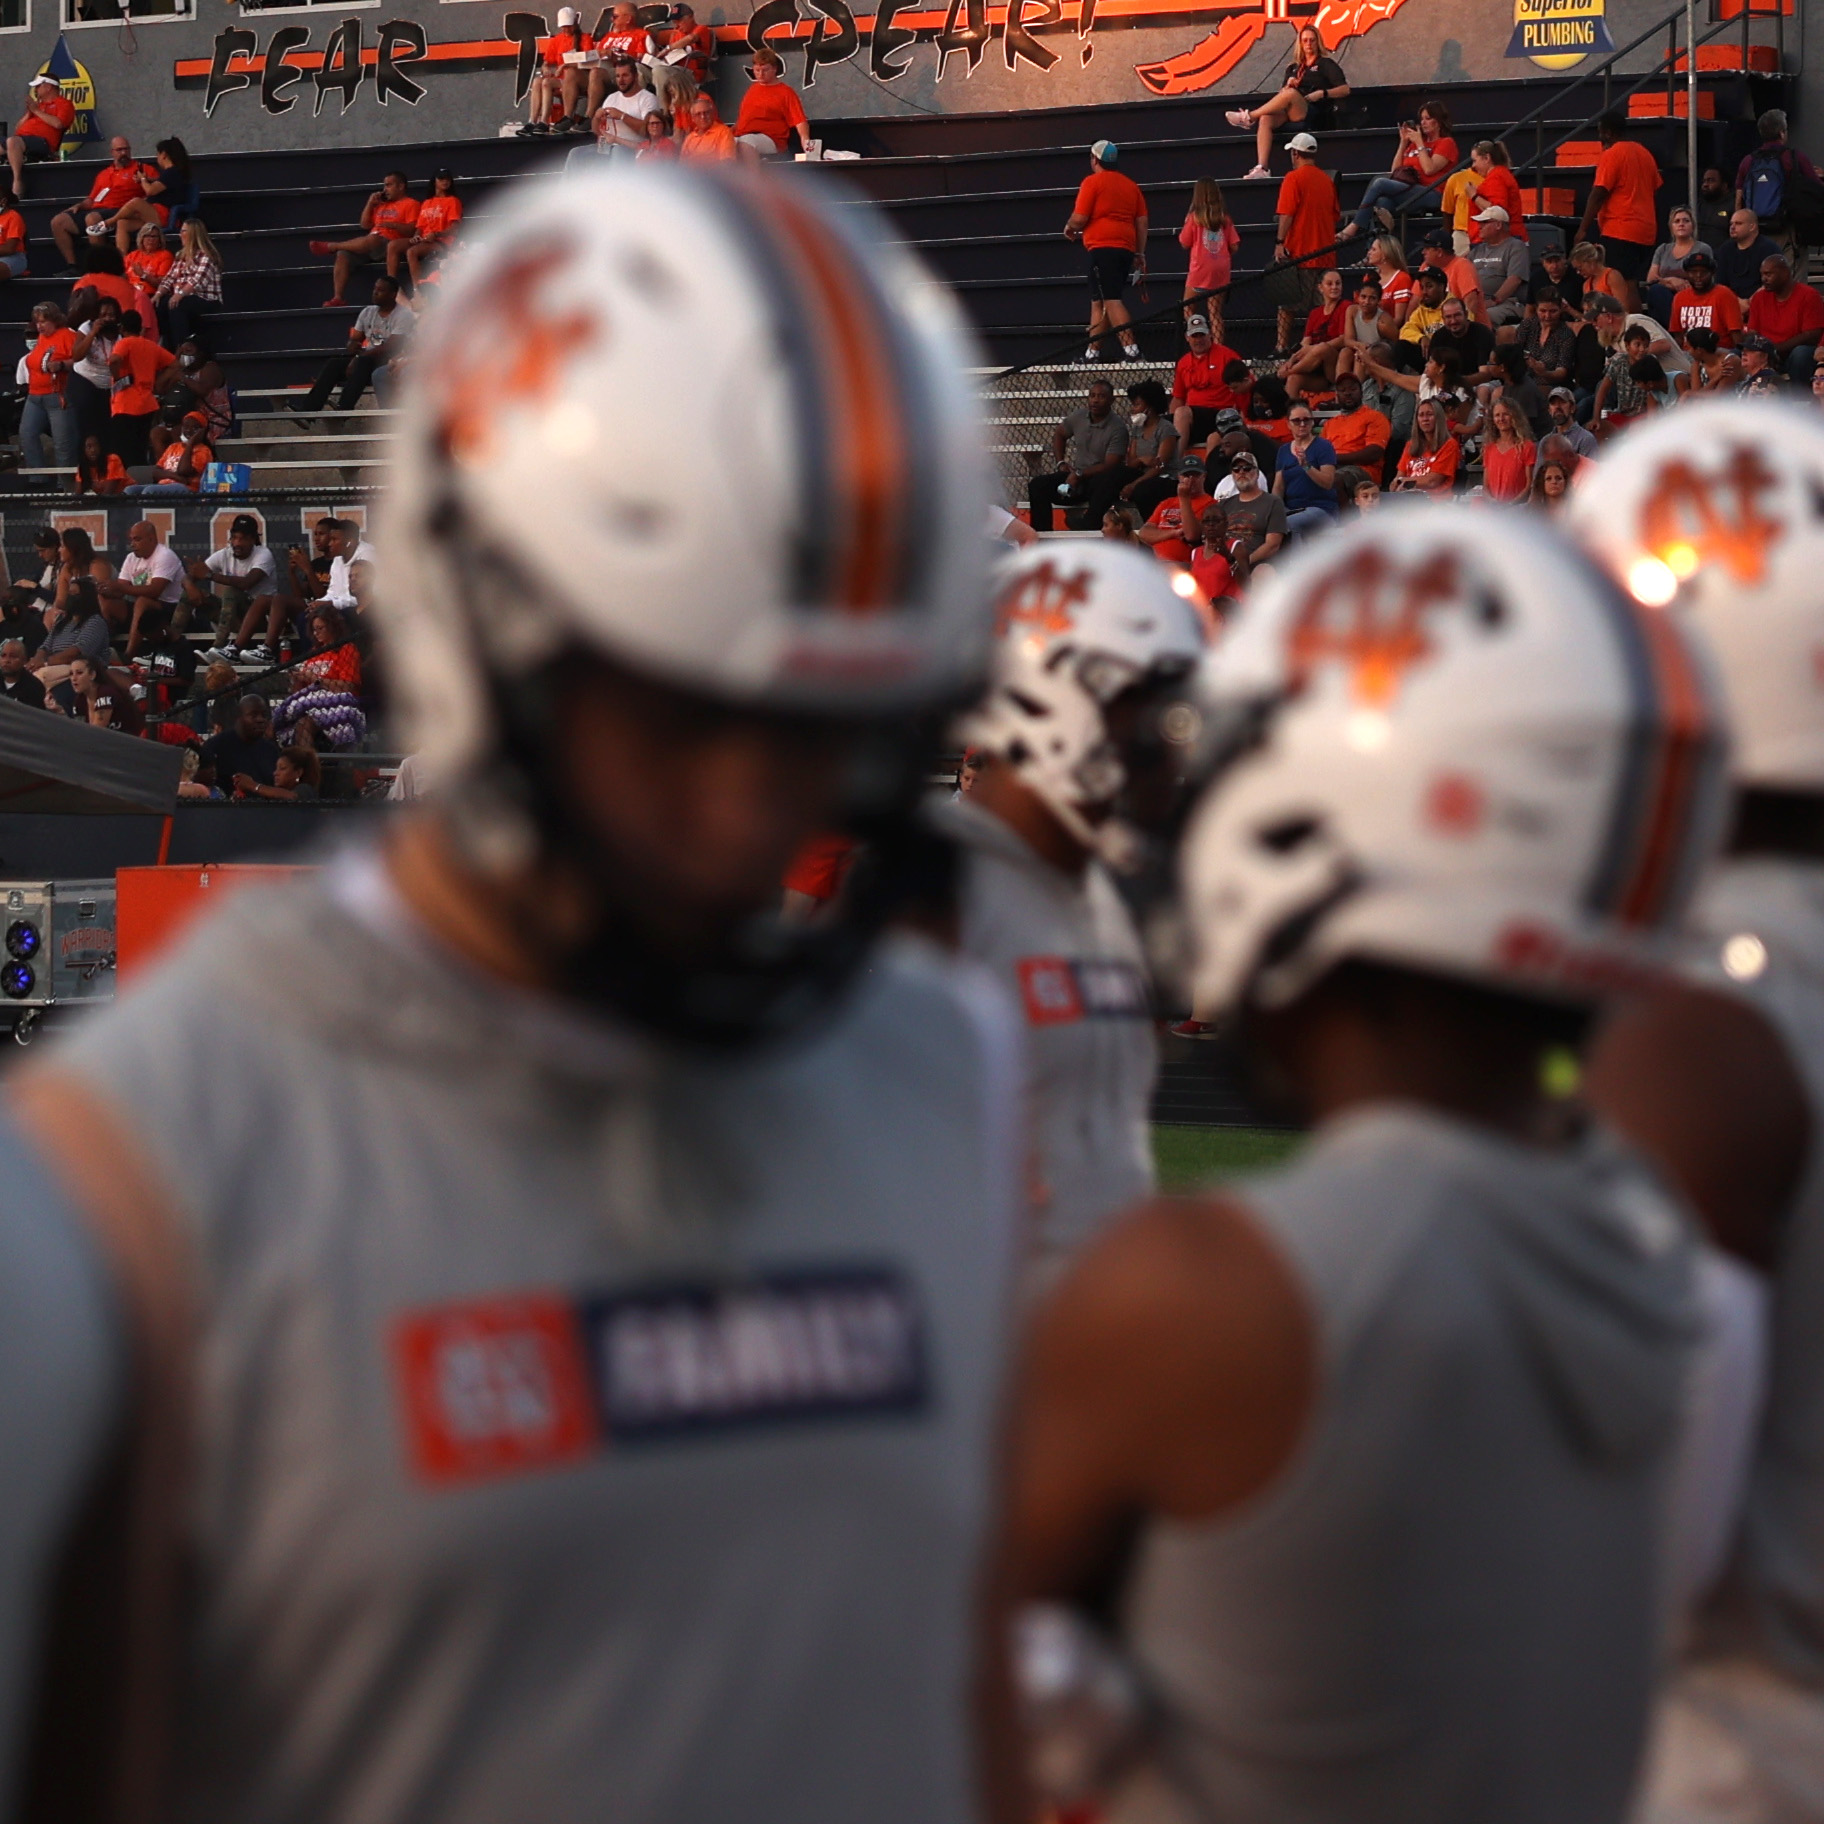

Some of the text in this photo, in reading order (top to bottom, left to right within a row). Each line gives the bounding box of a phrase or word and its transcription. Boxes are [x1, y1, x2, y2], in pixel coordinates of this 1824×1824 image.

[1523, 20, 1595, 48] PLUMBING
[204, 18, 428, 117] FEAR
[1680, 305, 1713, 317] NORTH
[1680, 317, 1712, 329] COBB
